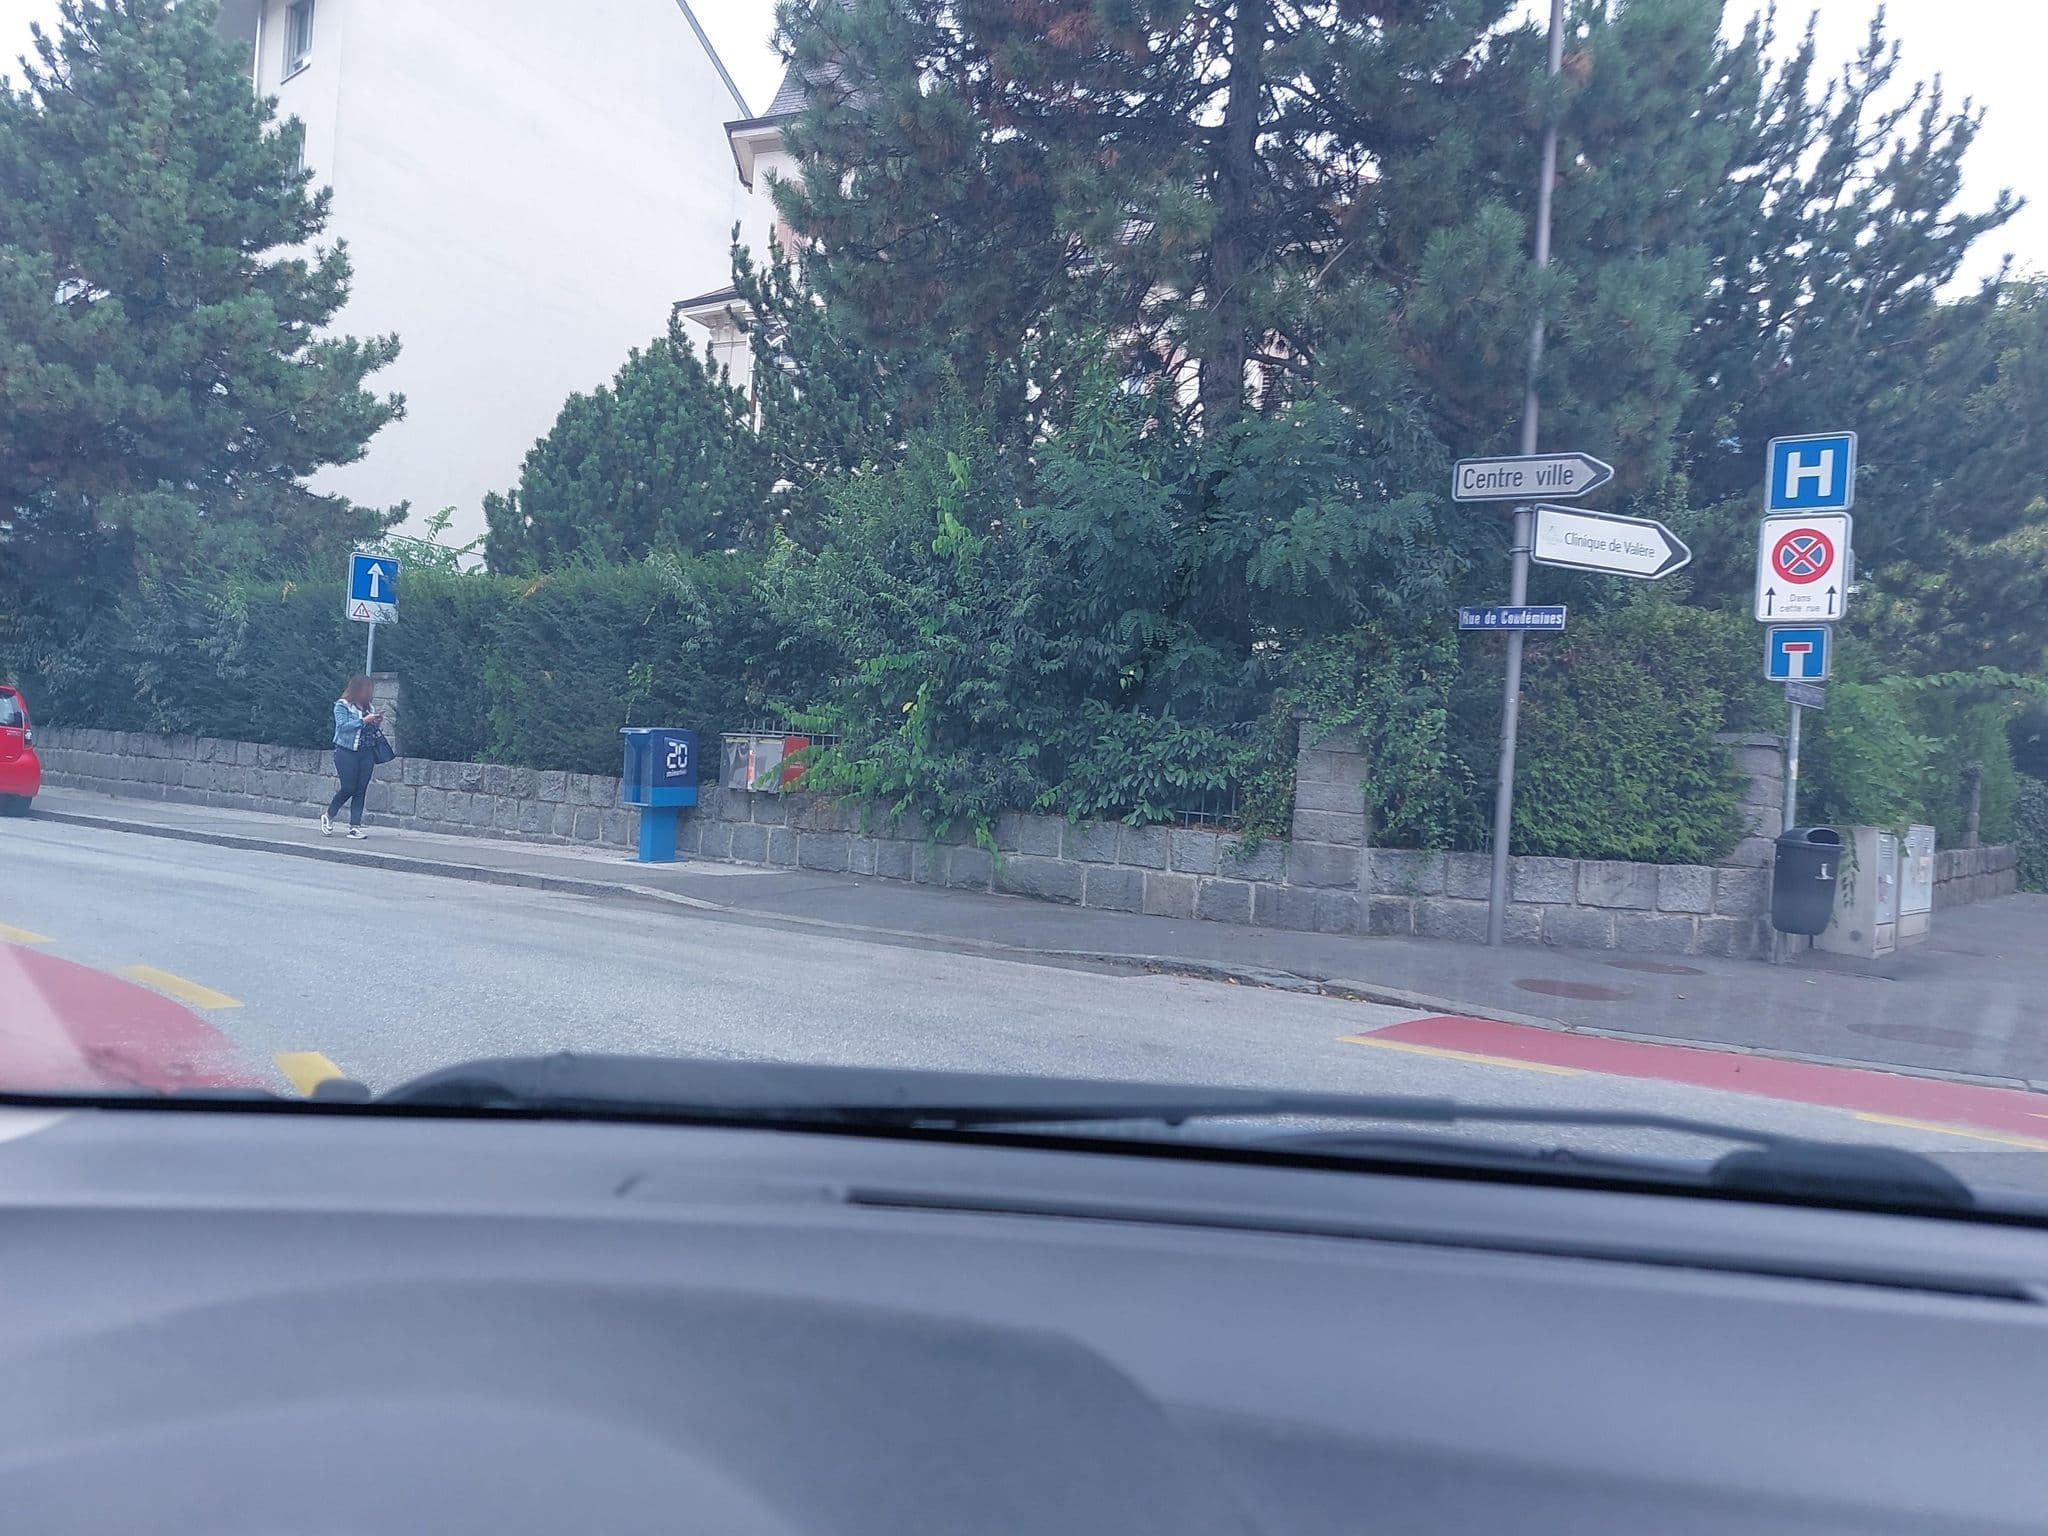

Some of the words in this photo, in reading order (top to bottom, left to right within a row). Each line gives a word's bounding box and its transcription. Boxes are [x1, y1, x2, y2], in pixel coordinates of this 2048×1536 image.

[1463, 467, 1523, 489] Centre
[1536, 464, 1574, 486] ville
[1785, 449, 1834, 499] H
[1564, 531, 1607, 551] Clinique
[1609, 538, 1622, 553] de
[1623, 541, 1656, 558] Valère
[1463, 611, 1481, 625] Rue
[1484, 611, 1497, 625] de
[1807, 604, 1821, 613] rue
[667, 742, 688, 768] 20
